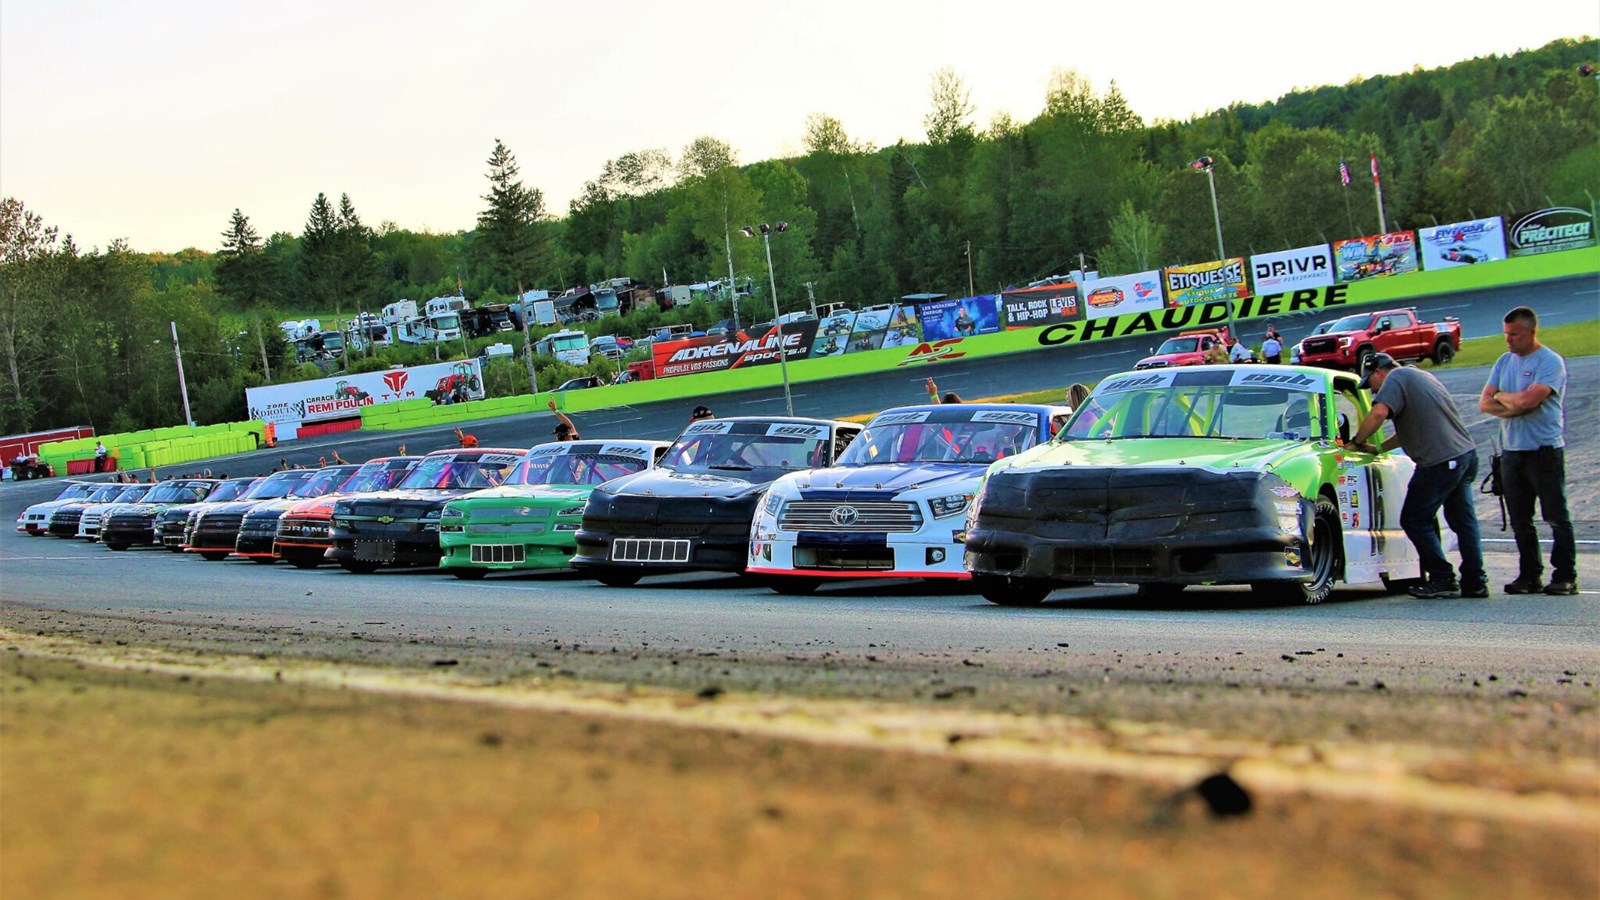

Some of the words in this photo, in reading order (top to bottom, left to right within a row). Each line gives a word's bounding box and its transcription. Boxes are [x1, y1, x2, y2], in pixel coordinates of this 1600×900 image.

[1256, 255, 1326, 279] DRIVR
[1169, 262, 1241, 290] ETIQUESSE
[1006, 303, 1027, 312] TALK,
[1028, 300, 1047, 310] ROCK
[1008, 313, 1014, 322] &
[1017, 309, 1048, 321] HIP-HOP
[1038, 285, 1349, 345] CHAUDIERE
[663, 364, 690, 375] PROPULSE
[691, 362, 701, 371] VOS
[702, 358, 729, 370] PASSIONS
[381, 391, 415, 400] TYM
[336, 397, 374, 410] POULIN
[260, 406, 296, 418] DROUIN
